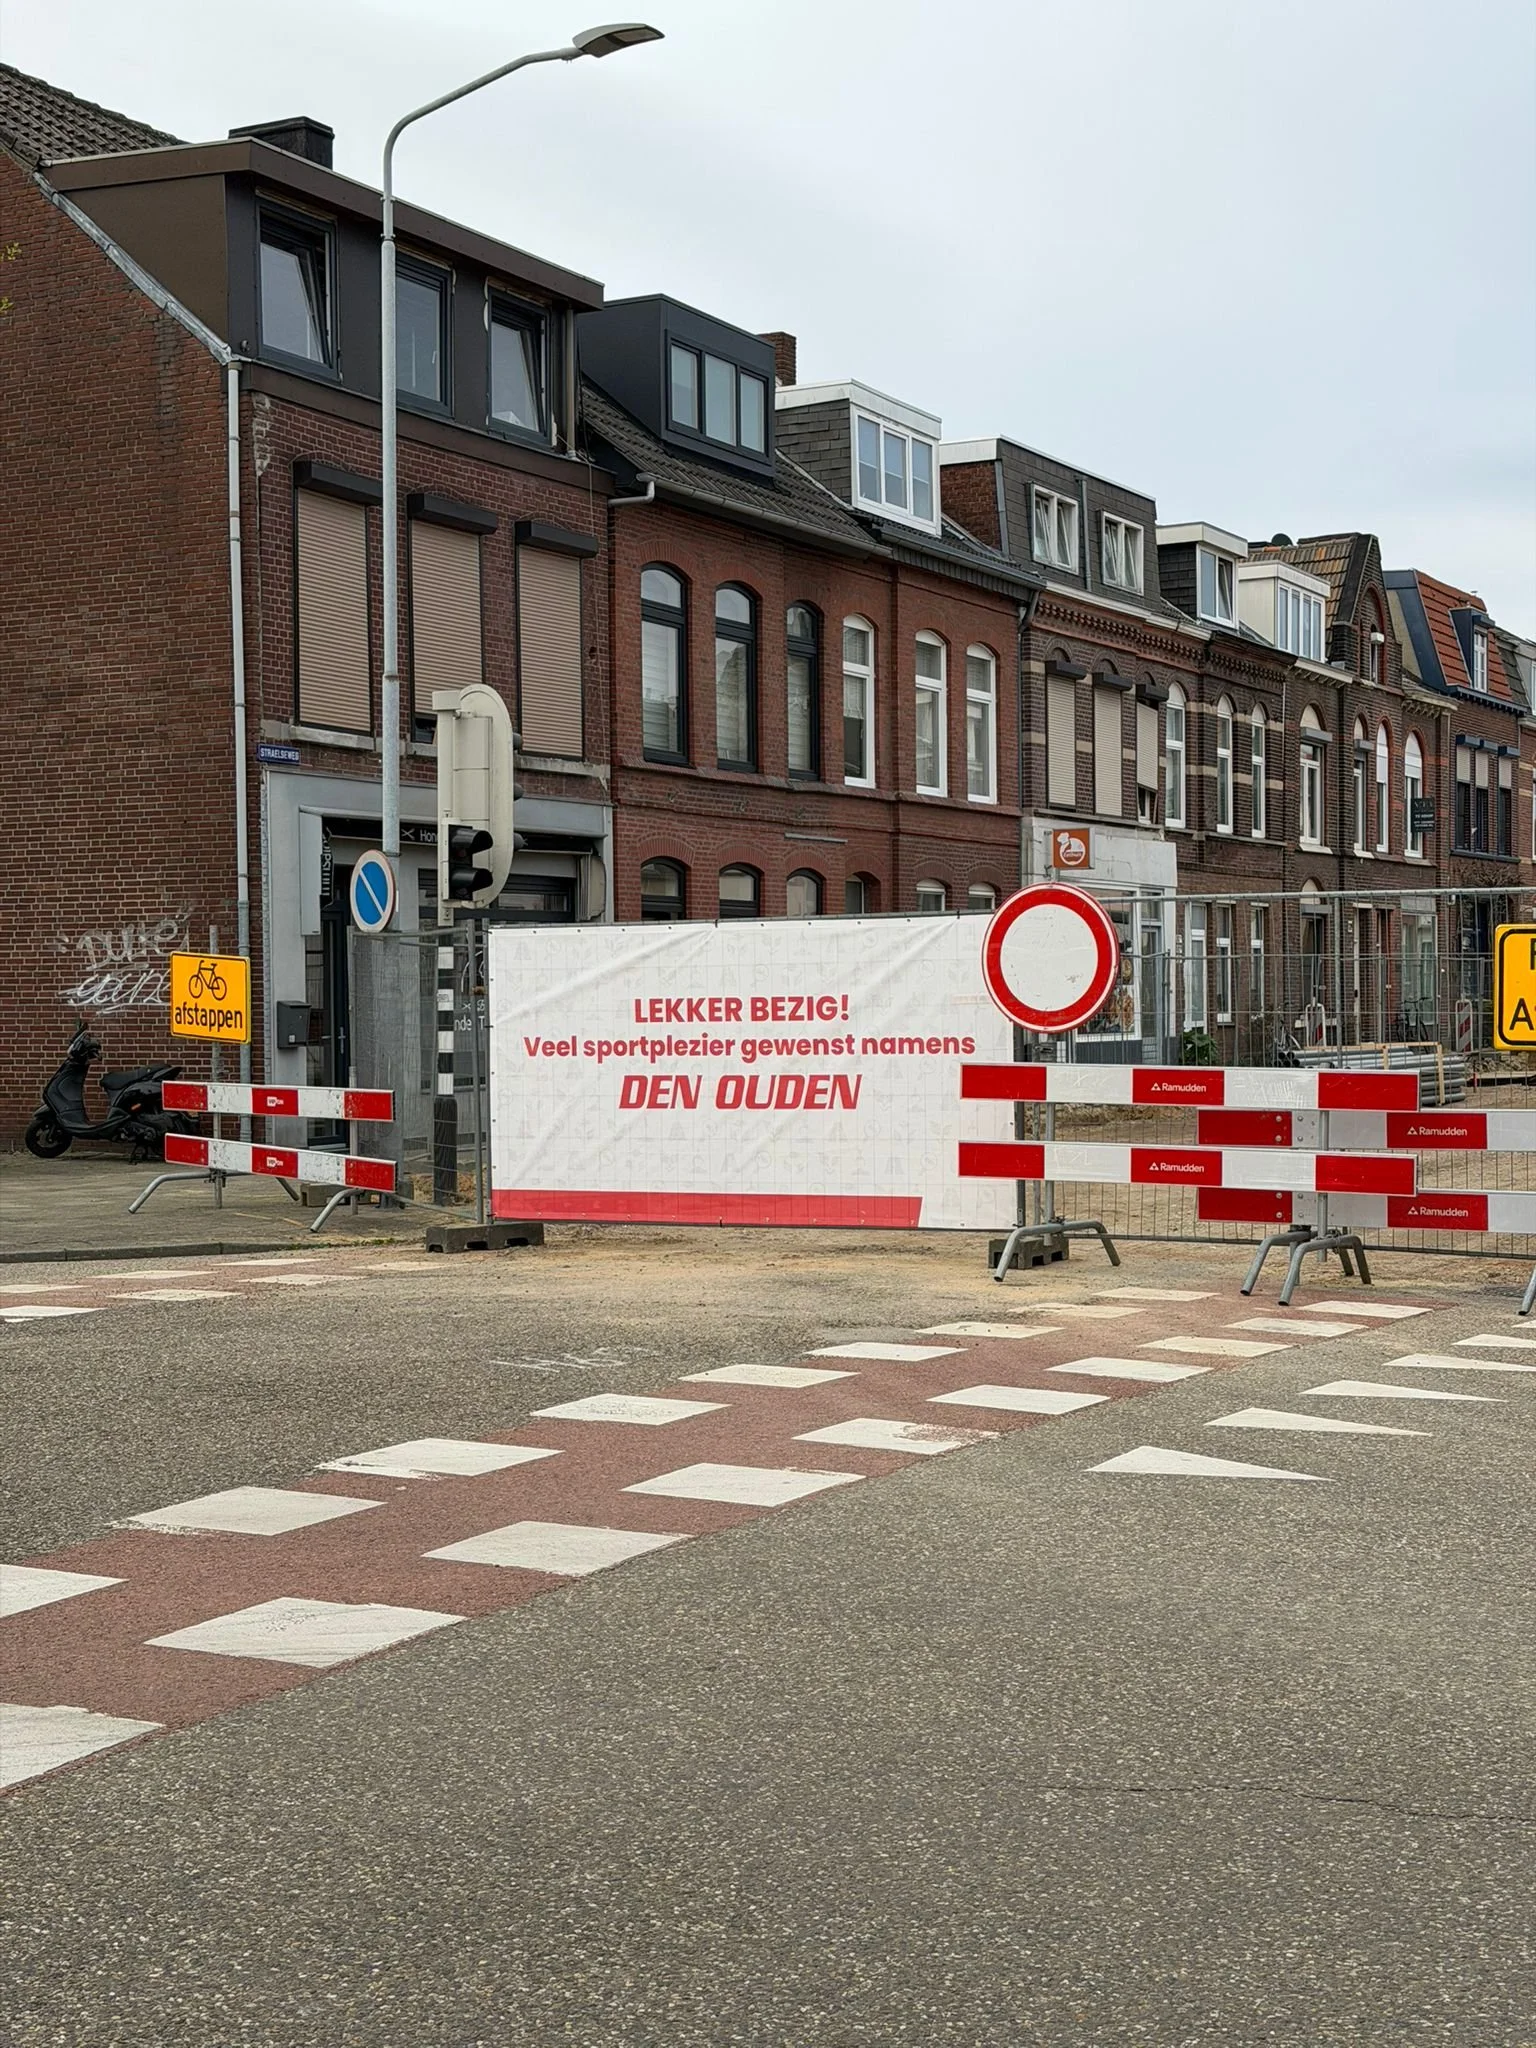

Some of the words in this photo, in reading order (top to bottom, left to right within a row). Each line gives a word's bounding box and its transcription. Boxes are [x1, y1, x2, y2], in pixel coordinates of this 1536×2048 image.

[174, 1001, 243, 1032] afstappen
[634, 997, 743, 1023] LEKKER
[750, 994, 850, 1022] BEZIG!
[523, 1036, 578, 1057] Veel
[583, 1032, 736, 1065] sportplezier
[740, 1034, 855, 1064] gewenst
[861, 1035, 977, 1055] namens
[618, 1074, 703, 1110] DEN
[714, 1073, 863, 1110] OUDEN
[1161, 1082, 1207, 1093] Ramudden
[1419, 1126, 1468, 1137] Ramudden
[1160, 1162, 1205, 1173] Ramudden
[1420, 1206, 1469, 1217] Ramudden
